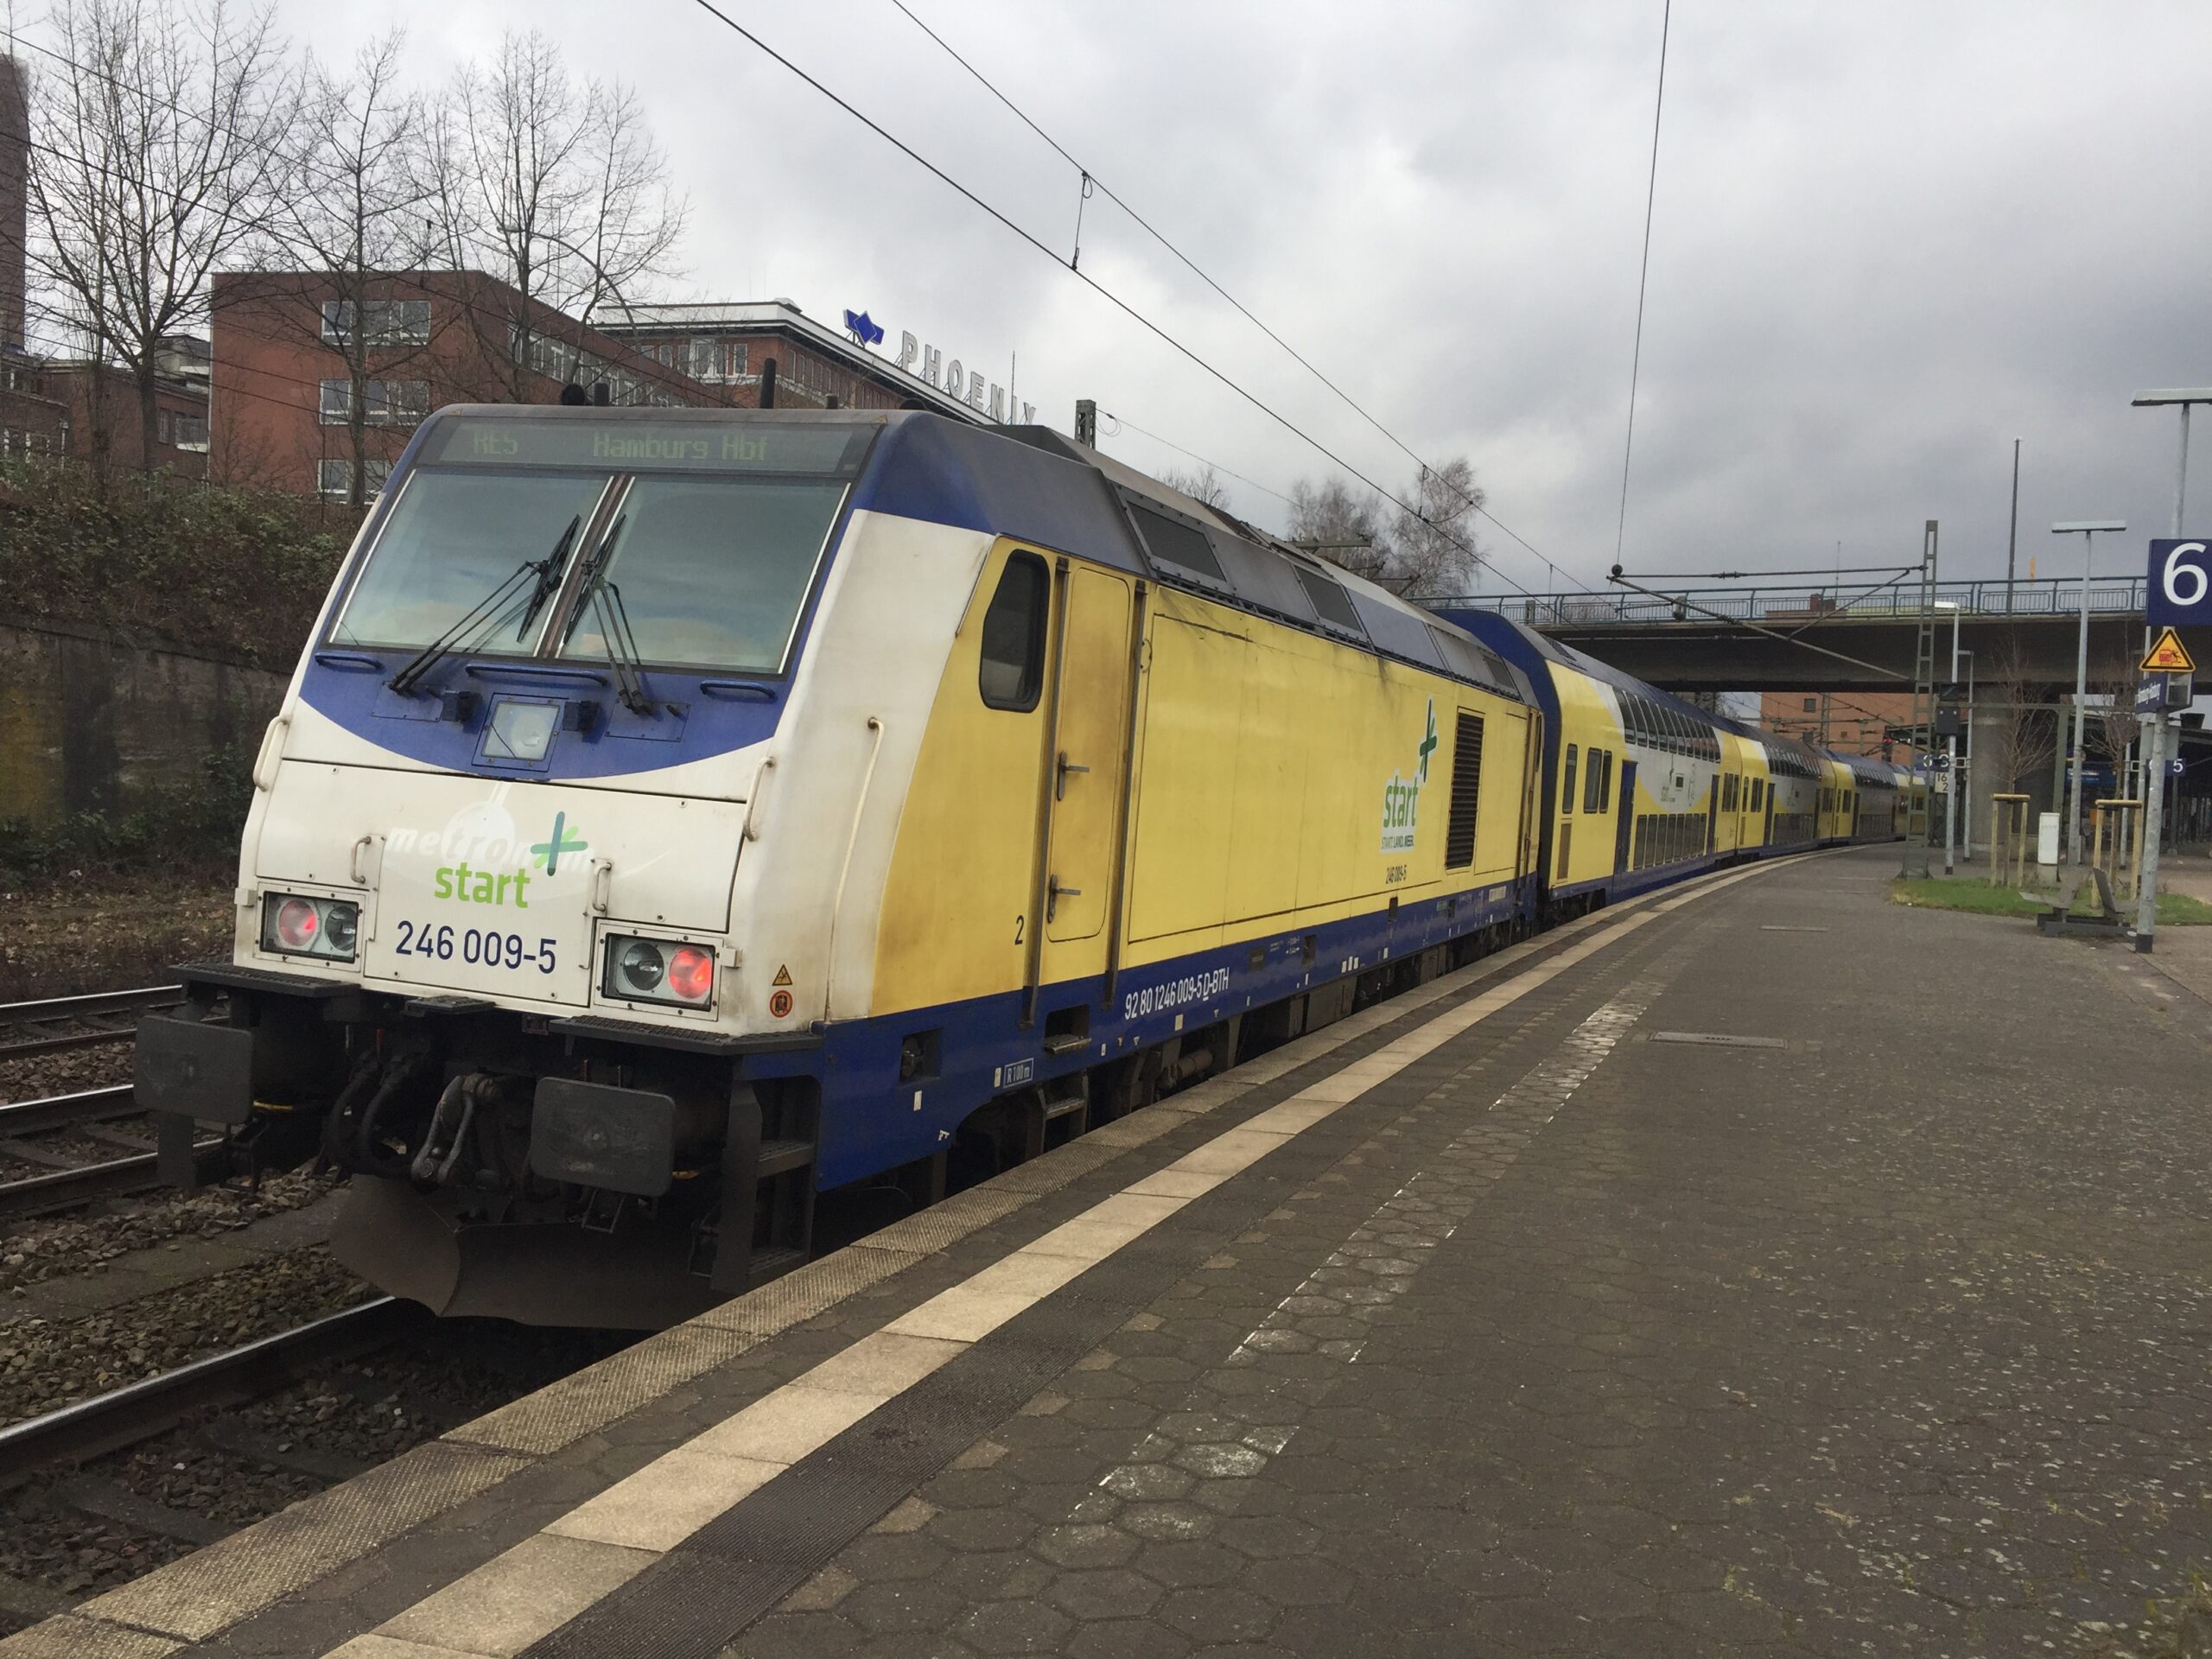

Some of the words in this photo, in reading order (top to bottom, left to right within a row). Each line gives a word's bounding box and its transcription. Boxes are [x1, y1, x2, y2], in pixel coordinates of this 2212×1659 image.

[593, 432, 709, 460] Hamburg
[721, 433, 768, 461] Hbf
[2163, 543, 2209, 606] 6
[2172, 758, 2183, 772] 5
[1383, 775, 1419, 828] start
[434, 861, 531, 908] start
[395, 920, 454, 960] 246
[463, 929, 557, 975] 009-5
[1014, 915, 1025, 945] 2
[1125, 991, 1139, 1020] 92
[1140, 988, 1154, 1015] 80
[1154, 982, 1177, 1011] 1246
[1177, 974, 1203, 1004] 009-5
[1203, 967, 1230, 1001] D-BTH
